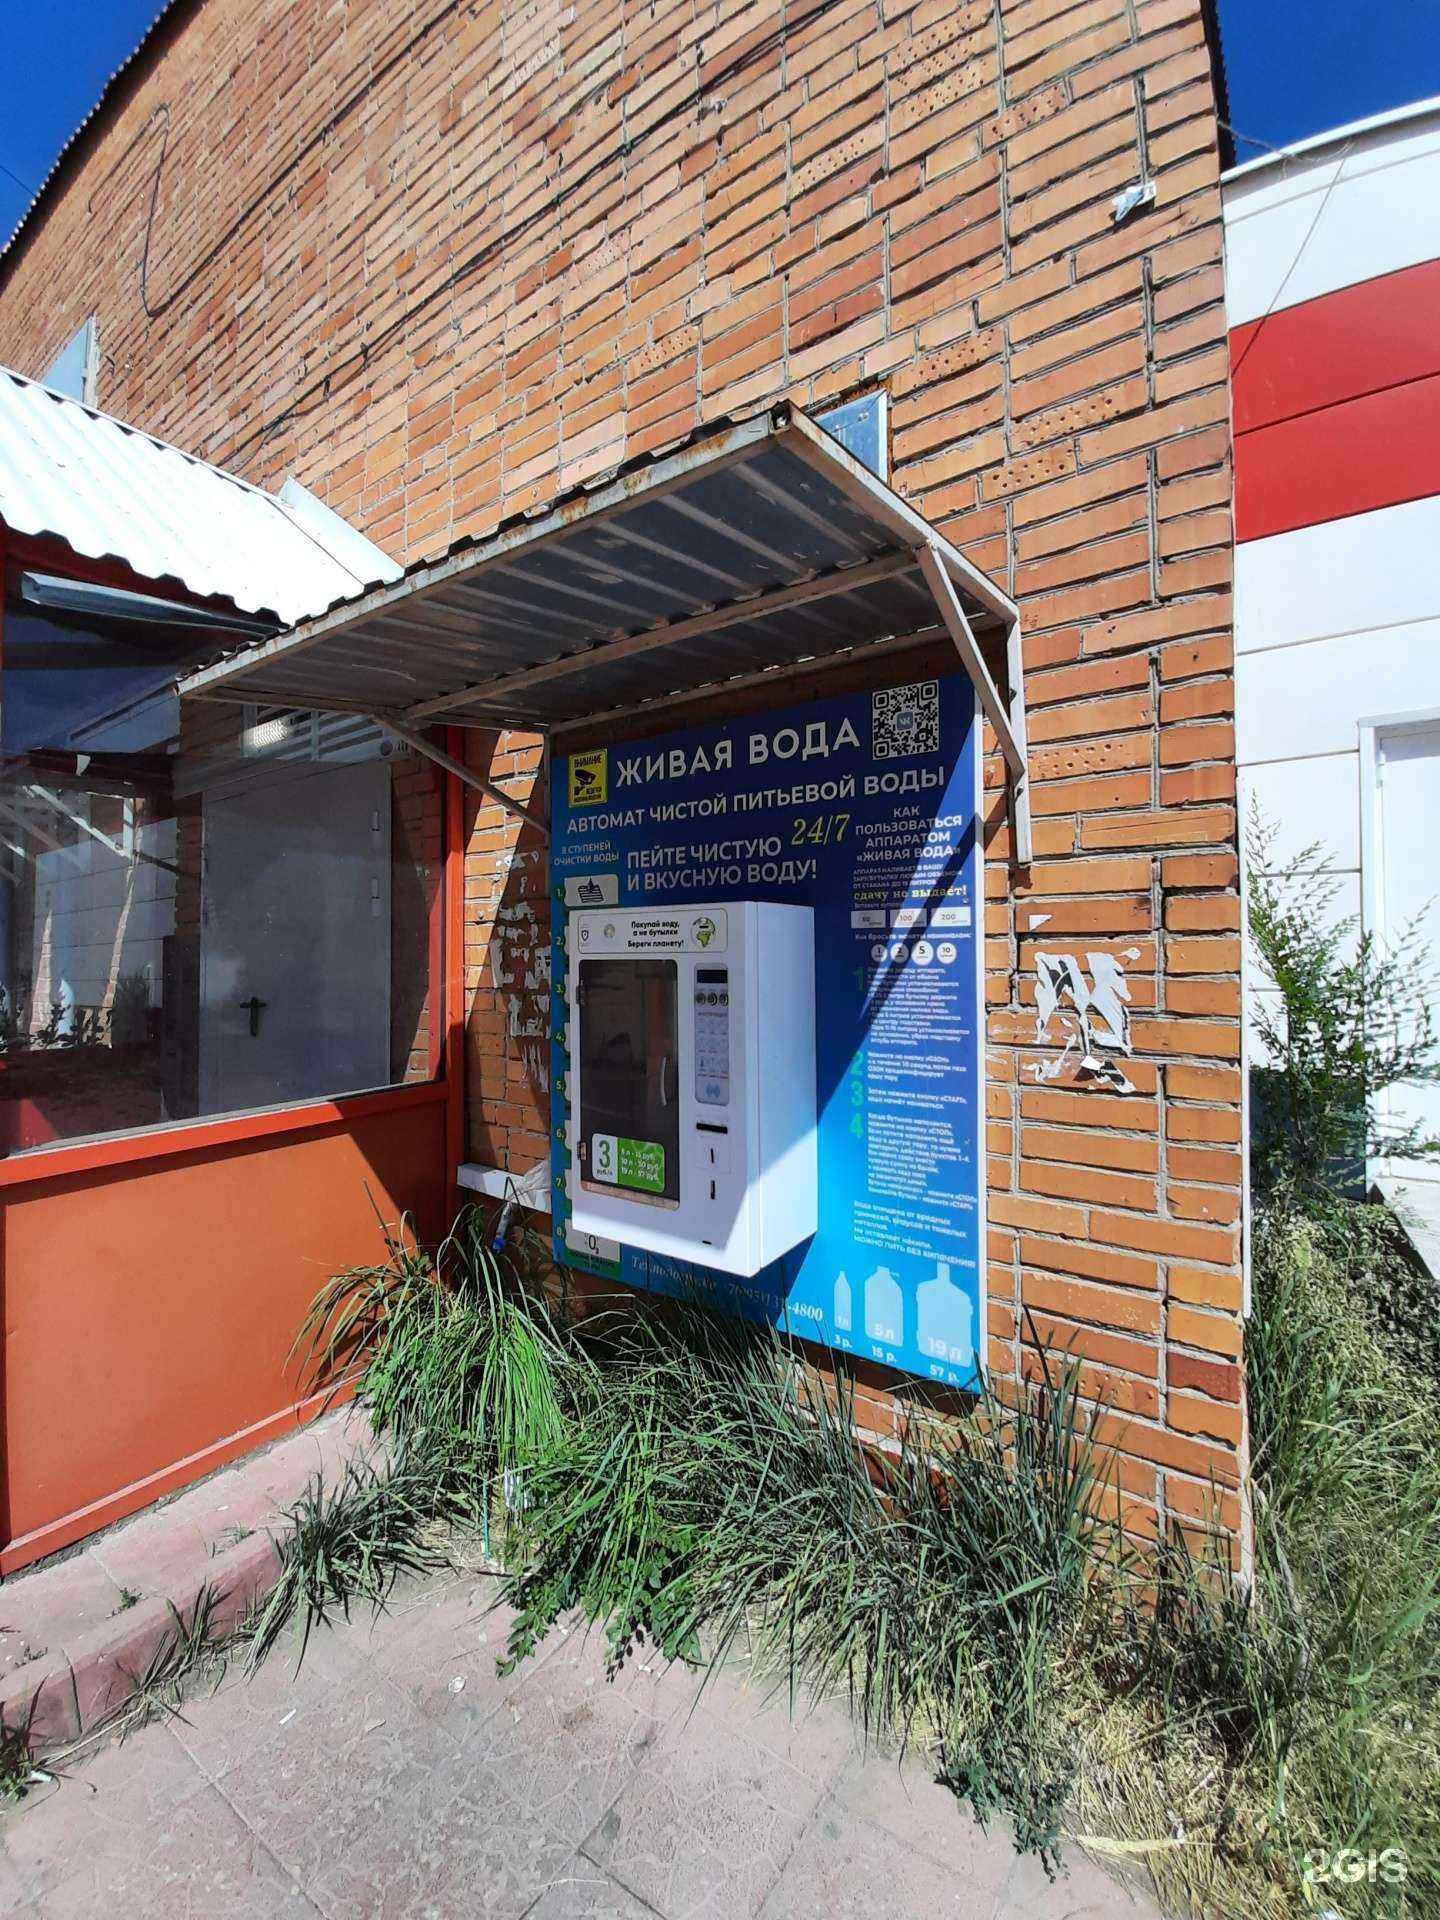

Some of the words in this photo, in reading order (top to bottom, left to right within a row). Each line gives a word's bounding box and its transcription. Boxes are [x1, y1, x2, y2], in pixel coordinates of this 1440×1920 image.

[616, 740, 732, 788] ЖИВАЯ
[750, 717, 861, 765] ВОДА
[567, 809, 645, 835] АВТОМАТ
[650, 794, 727, 822] ЧИСТОЙ
[733, 774, 856, 812] ПИТЬЕВОЙ
[864, 766, 944, 795] ВОДЫ
[893, 806, 919, 818] КАК
[791, 814, 850, 846] 24/7
[855, 815, 962, 835] ПОЛЬЗОВАТЬСЯ
[568, 840, 611, 854] СТУПЕНЕЙ
[865, 831, 951, 848] АППАРАТОМ
[554, 855, 592, 866] ОЧИСТКИ
[593, 852, 619, 863] ВОДЫ
[627, 845, 686, 869] ПЕЙТЕ
[691, 837, 781, 862] ЧИСТУЮ
[857, 848, 910, 862] «ЖИВАЯ
[914, 845, 960, 858] ВОДА»
[628, 874, 639, 891] И
[644, 865, 741, 890] ВКУСНУЮ
[748, 859, 817, 884] ВОДУ!
[854, 891, 889, 901] сдачу
[893, 890, 908, 898] не
[631, 920, 661, 929] Покупай
[662, 920, 680, 929] воду,
[648, 928, 678, 937] бутылки
[627, 940, 651, 949] Береги
[652, 939, 685, 948] планету!
[919, 946, 925, 954] 5
[850, 1050, 863, 1075] 2
[556, 1080, 564, 1090] 5.
[851, 1081, 864, 1106] 3
[848, 1113, 864, 1138] 4
[599, 1140, 611, 1168] 3
[854, 1235, 884, 1248] МОЖНО
[907, 1246, 921, 1256] БЕЗ
[874, 1323, 882, 1336] 5
[883, 1329, 894, 1341] л
[834, 1334, 841, 1344] 3
[842, 1339, 853, 1349] р.
[928, 1337, 946, 1354] 19
[948, 1348, 962, 1361] л
[872, 1346, 883, 1359] 15
[886, 1352, 898, 1364] р.
[929, 1364, 944, 1378] 57
